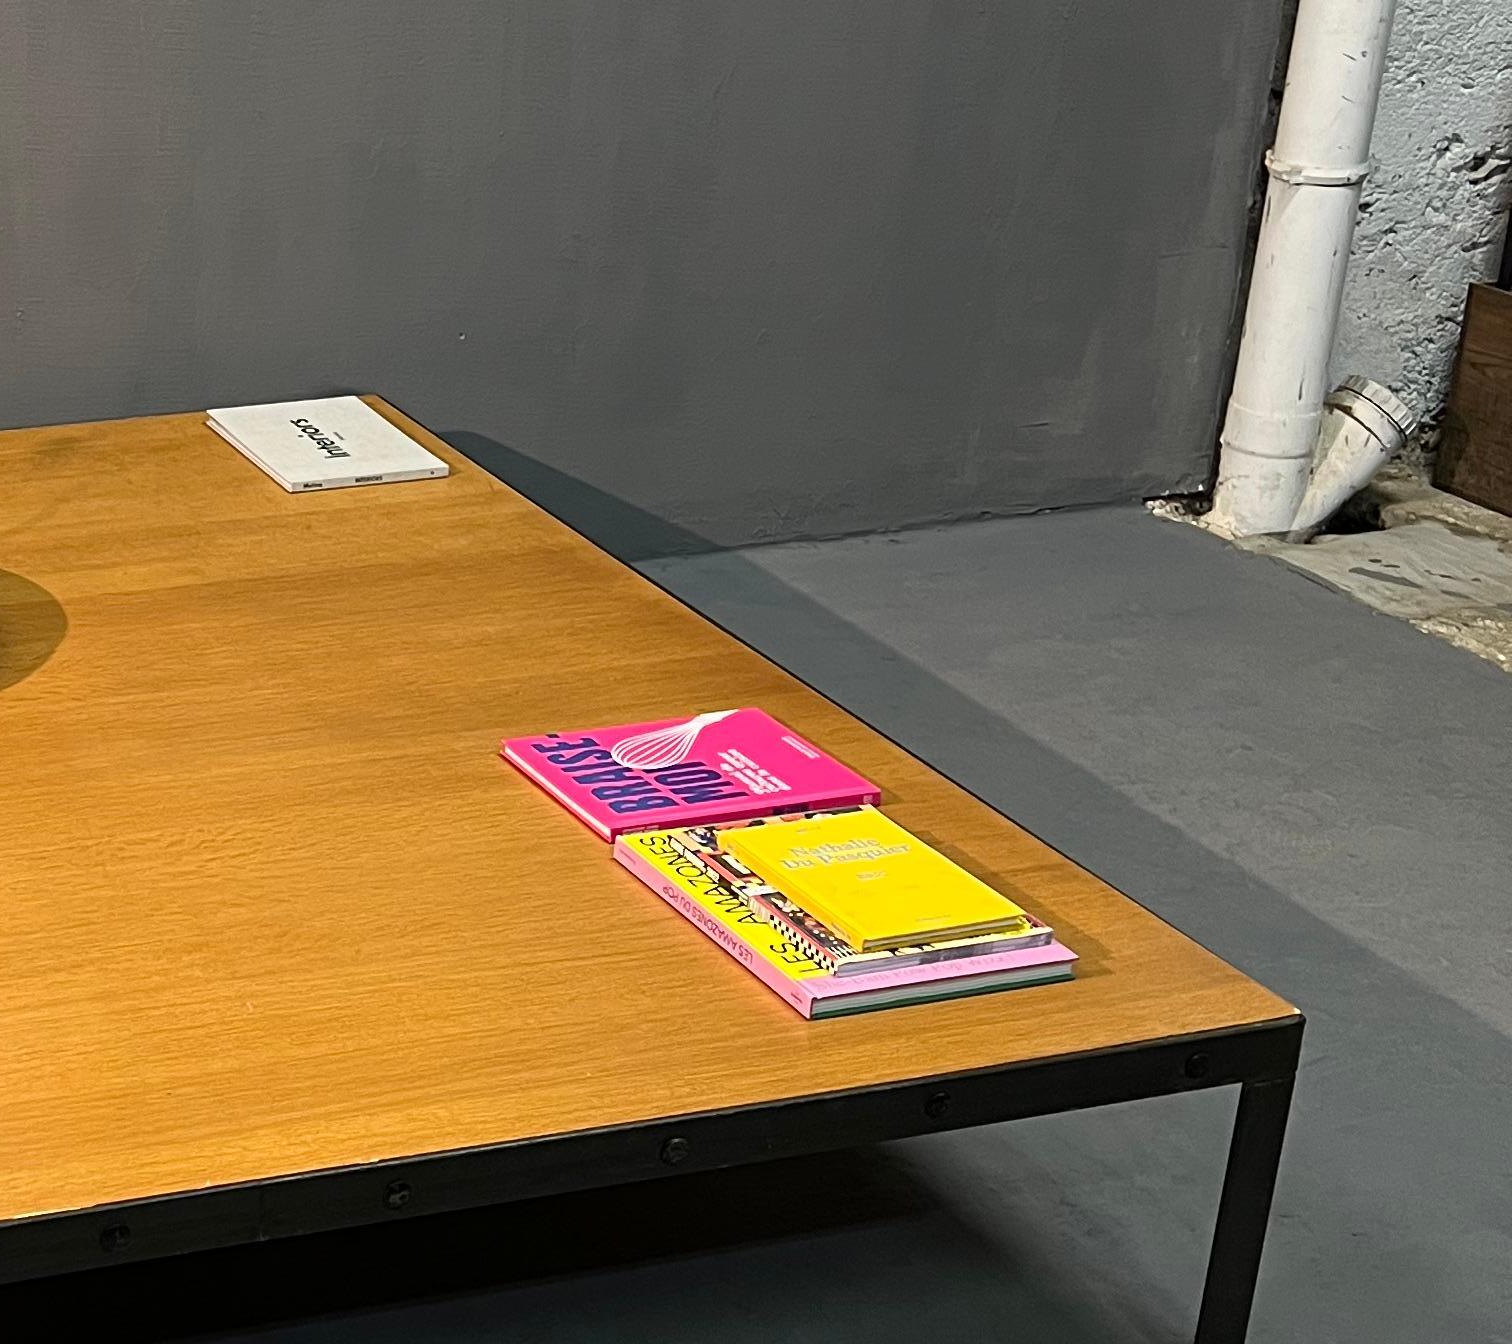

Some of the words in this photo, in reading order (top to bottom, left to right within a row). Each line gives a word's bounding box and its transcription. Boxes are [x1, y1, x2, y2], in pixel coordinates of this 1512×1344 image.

[290, 418, 351, 459] Interiors
[789, 838, 880, 857] Nathalie
[640, 835, 770, 925] AMAZONES
